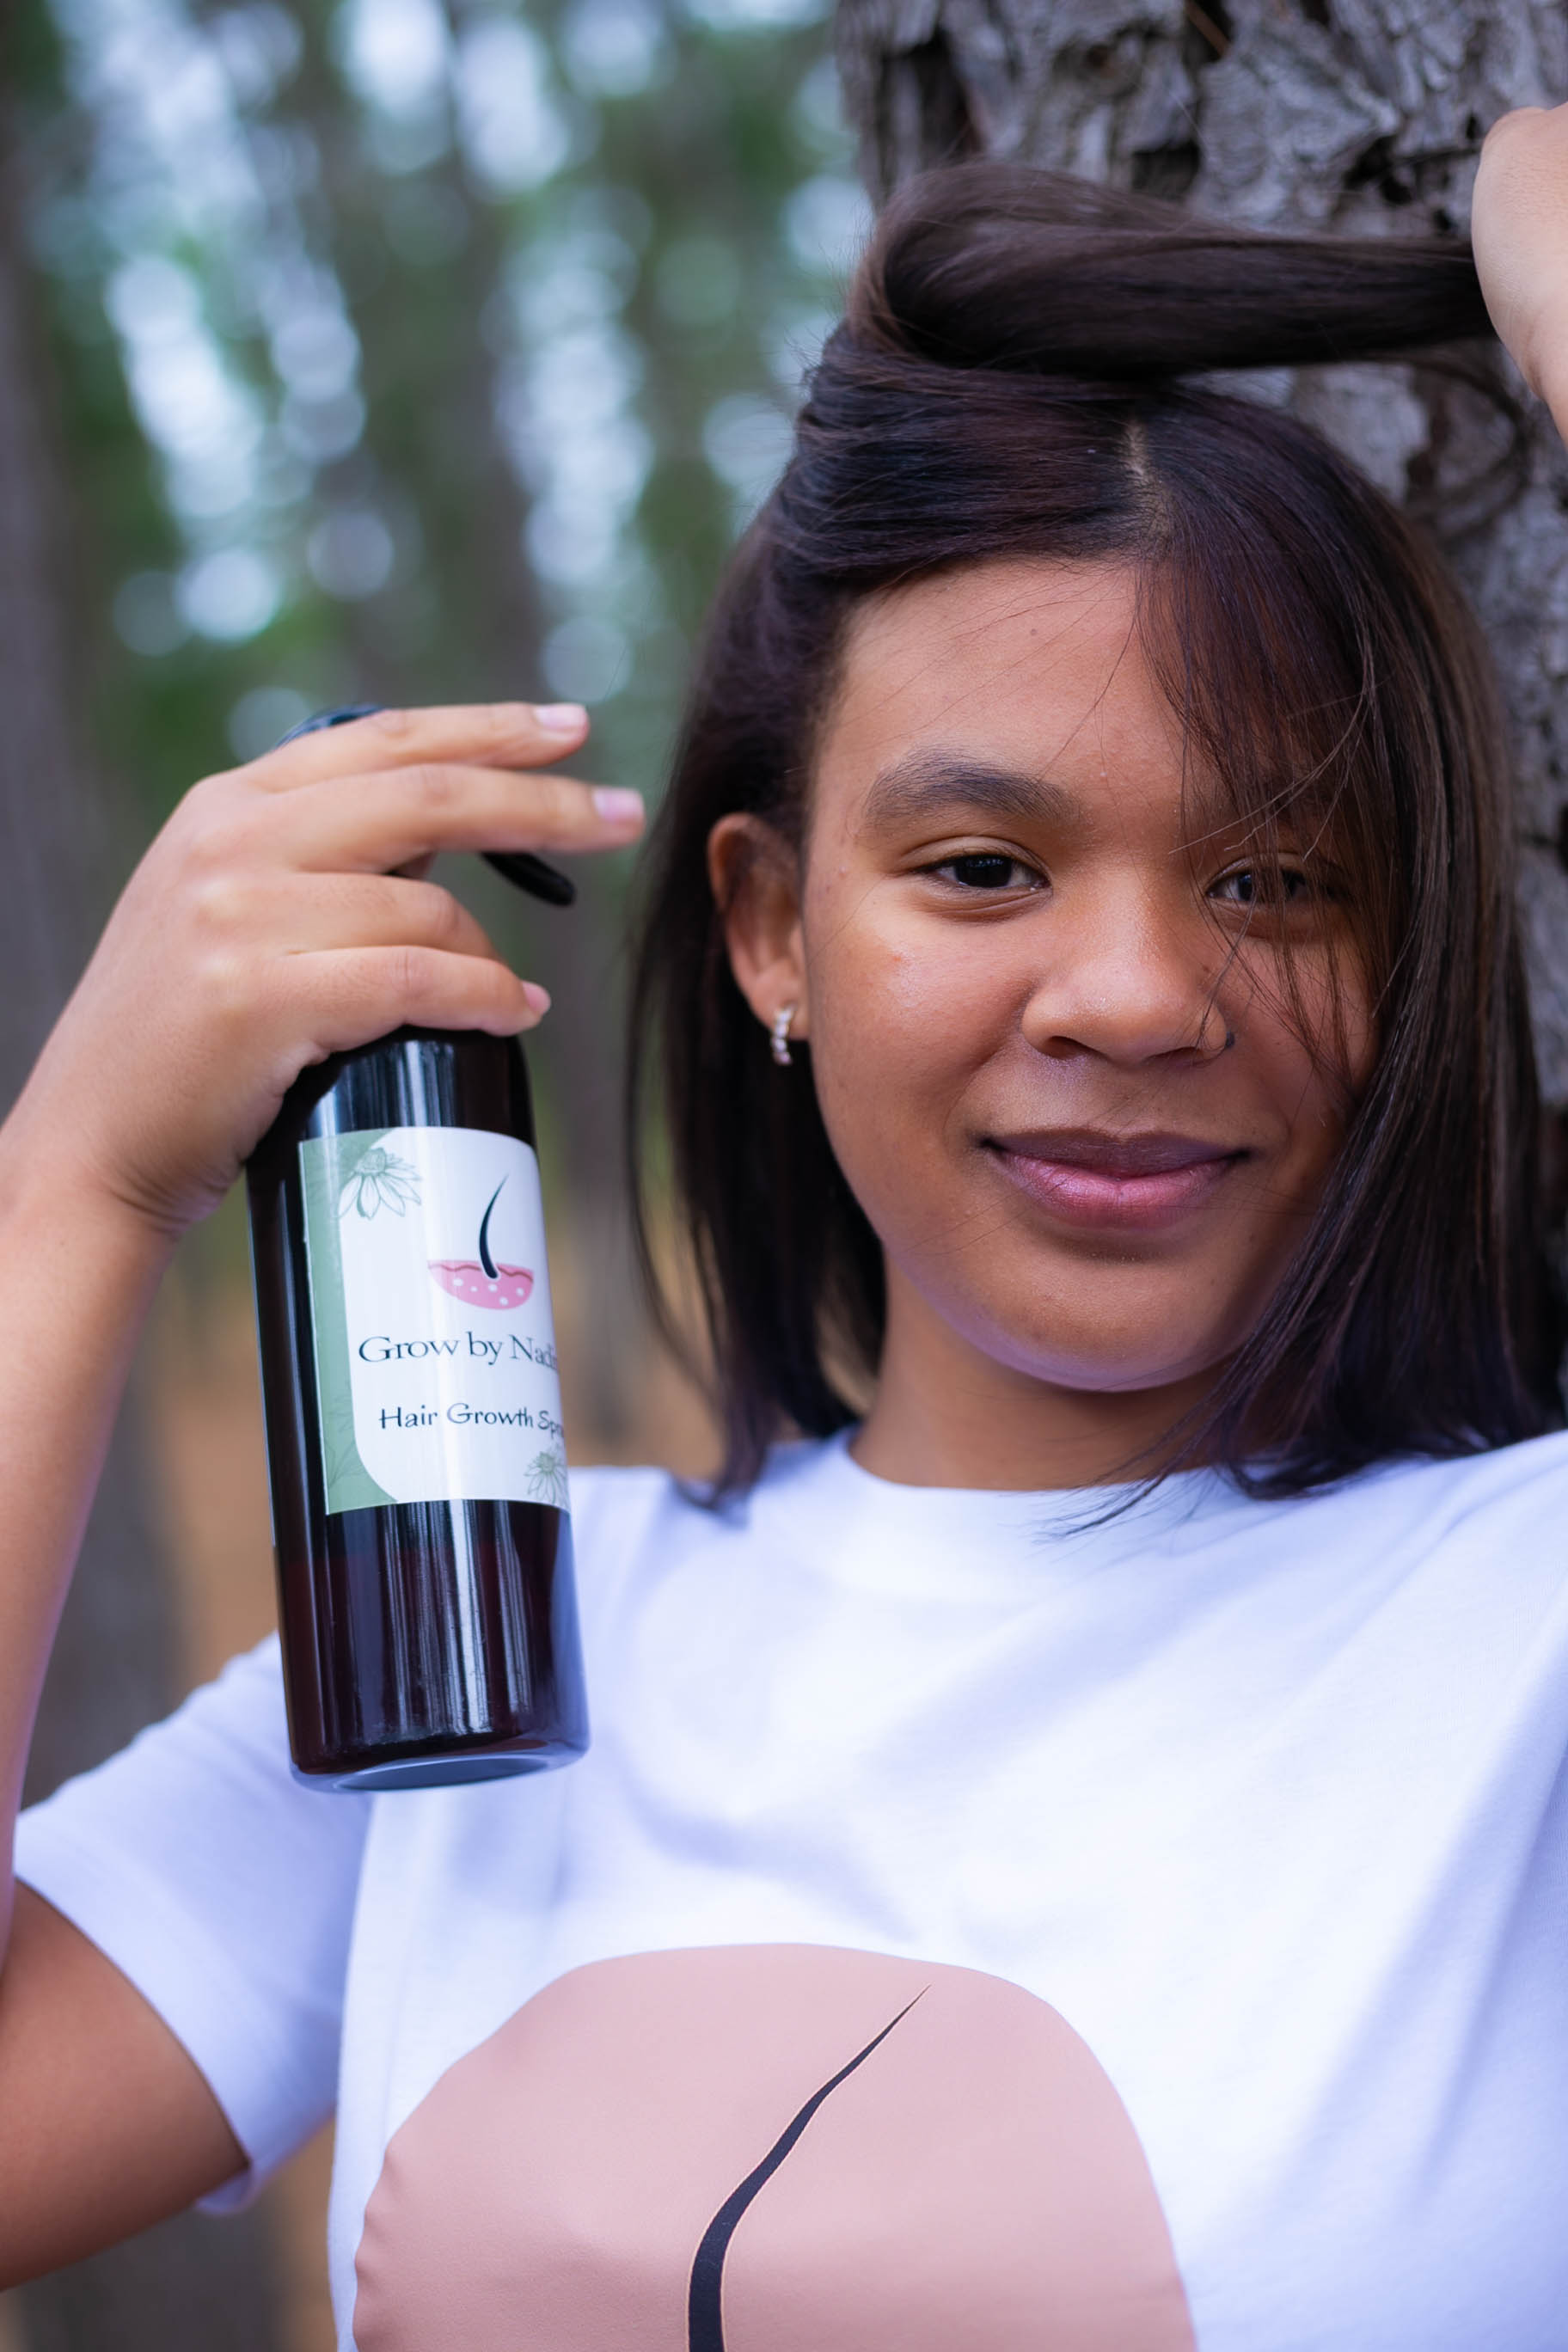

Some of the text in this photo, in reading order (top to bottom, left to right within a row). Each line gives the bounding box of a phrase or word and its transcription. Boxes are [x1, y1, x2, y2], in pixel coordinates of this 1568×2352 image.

[358, 1336, 459, 1363] Grow
[466, 1331, 503, 1365] by
[378, 1405, 438, 1430] Hair
[446, 1402, 534, 1428] Growth
